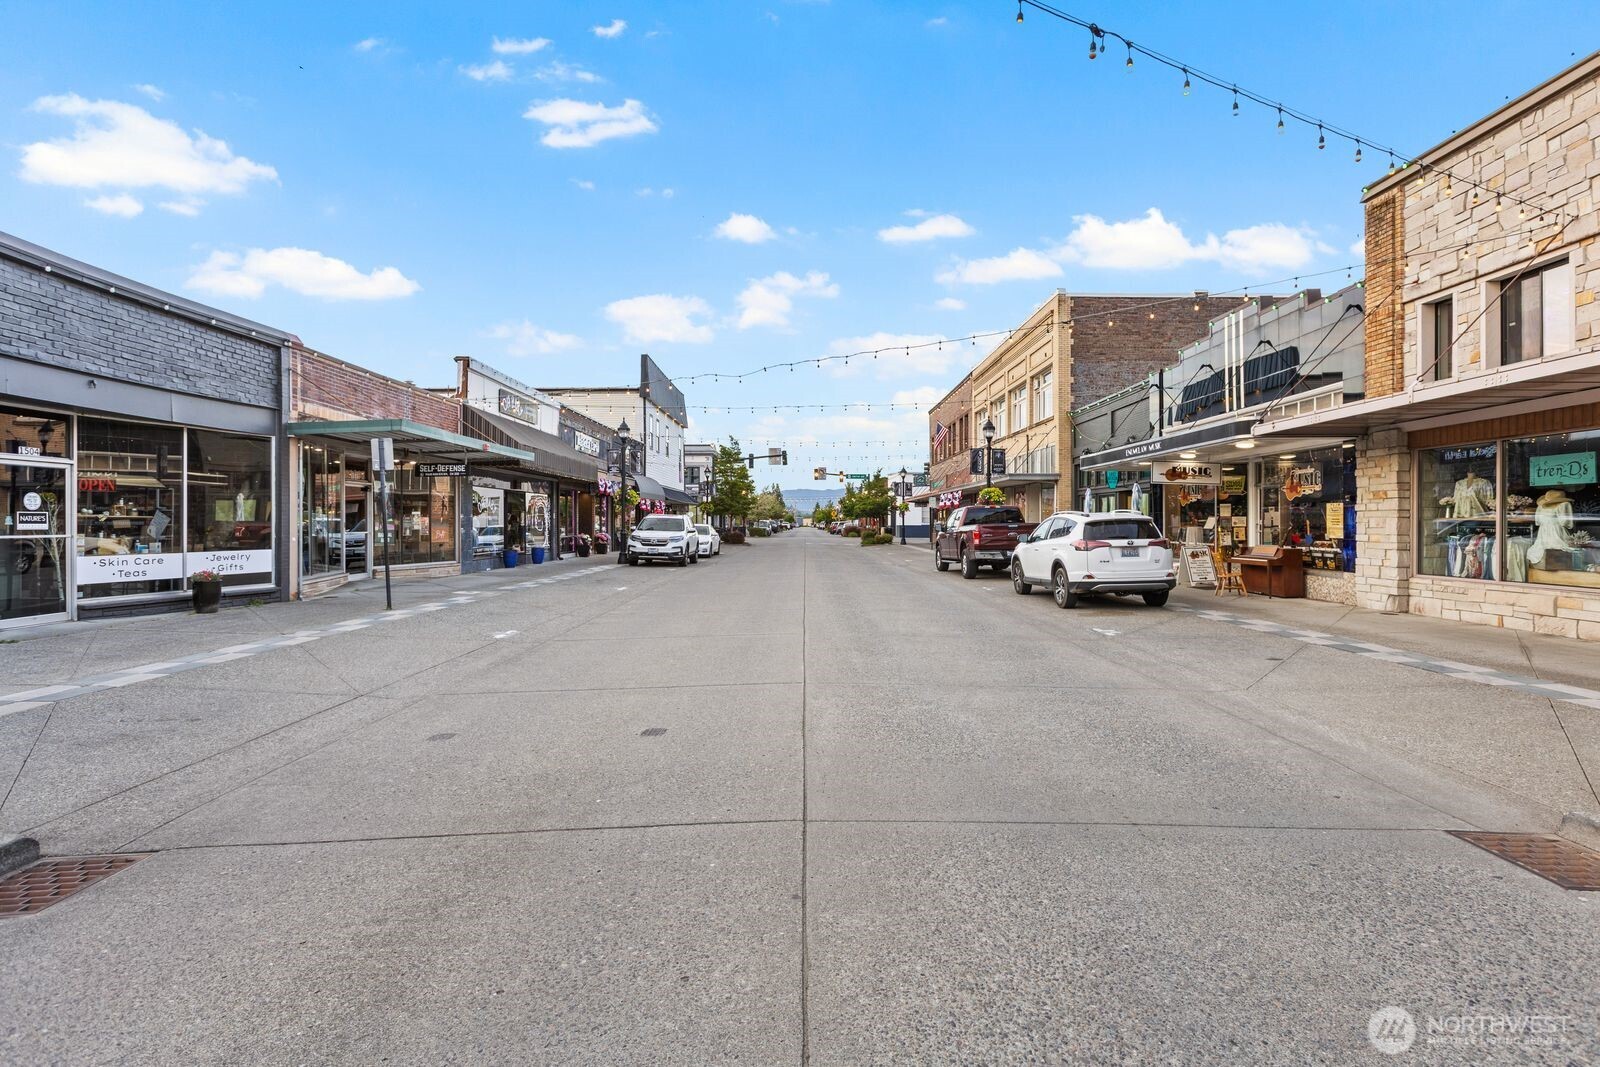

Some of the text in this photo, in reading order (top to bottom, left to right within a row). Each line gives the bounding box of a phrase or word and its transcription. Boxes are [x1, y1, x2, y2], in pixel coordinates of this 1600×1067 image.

[20, 446, 39, 455] 1504
[419, 464, 466, 472] SELF-DEFENSE
[1172, 466, 1212, 475] MUSIC
[79, 478, 115, 492] OPEN
[99, 557, 165, 567] Skin Care
[210, 553, 251, 562] Jewelry
[217, 563, 244, 572] Gifts
[117, 569, 148, 578] Teas
